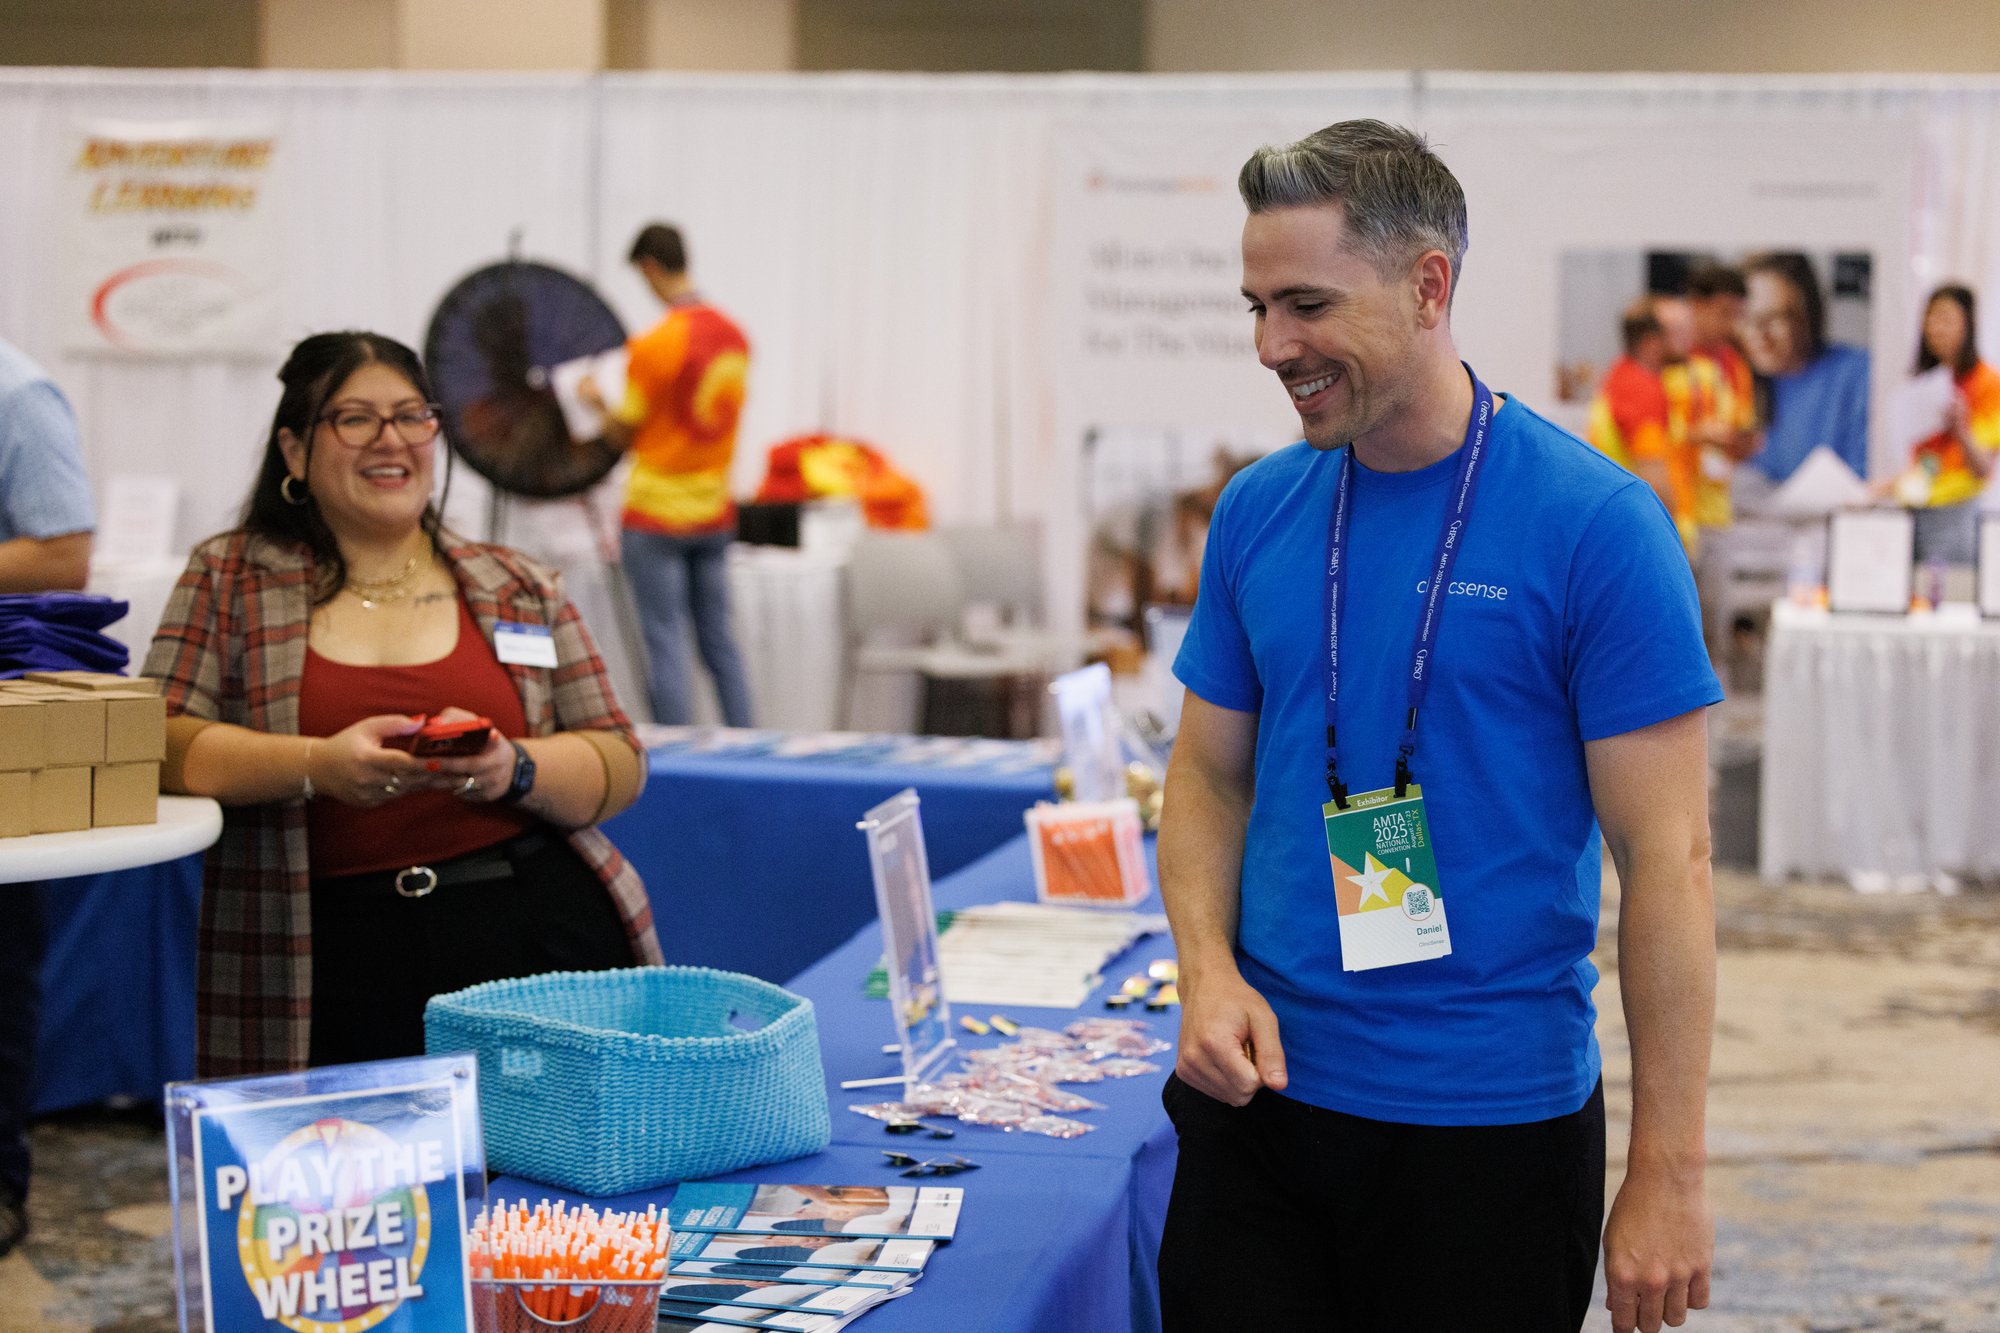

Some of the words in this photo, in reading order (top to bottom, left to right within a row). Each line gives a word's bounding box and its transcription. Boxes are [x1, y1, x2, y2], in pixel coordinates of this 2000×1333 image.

[1475, 429, 1484, 445] AMTA
[1471, 446, 1480, 460] 2025
[1465, 460, 1476, 483] National
[1457, 483, 1469, 514] Convention
[1440, 553, 1449, 570] AMTA
[1435, 570, 1444, 585] 2025
[1416, 576, 1508, 600] clcsense
[1430, 584, 1440, 609] National
[1422, 609, 1434, 642] Convention
[1357, 796, 1388, 807] Exhibitor
[1373, 812, 1406, 829] AMTA
[1411, 809, 1419, 821] TX
[1374, 823, 1408, 843] 2025
[1408, 827, 1417, 848] August
[1376, 838, 1409, 850] NATIONAL
[1377, 845, 1411, 855] CONVENTION
[1416, 924, 1442, 936] Daniel
[216, 1150, 341, 1210] PLAY
[348, 1140, 446, 1190] THE
[266, 1201, 404, 1261] PRIZE
[254, 1257, 424, 1320] WHEEL
